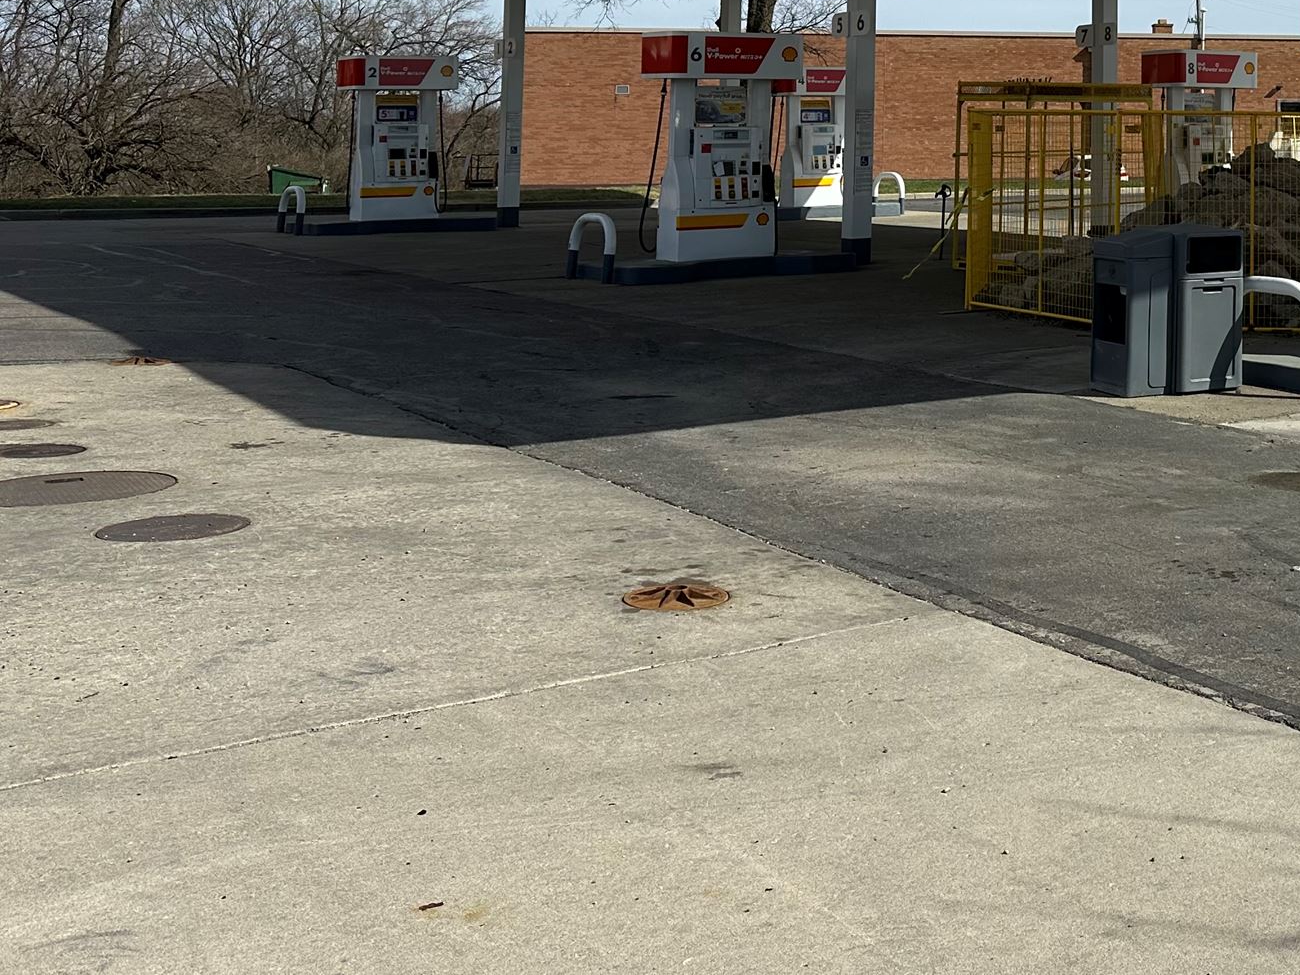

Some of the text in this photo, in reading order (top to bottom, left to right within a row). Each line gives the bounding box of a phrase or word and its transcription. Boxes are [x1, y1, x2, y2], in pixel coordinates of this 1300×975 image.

[836, 17, 843, 34] 5
[857, 14, 865, 31] 6
[1081, 29, 1088, 43] 7
[1104, 26, 1111, 41] 8
[507, 41, 513, 54] 2
[690, 47, 702, 62] 6
[706, 52, 738, 60] V-Power
[368, 66, 377, 78] 2
[1188, 62, 1195, 75] 8
